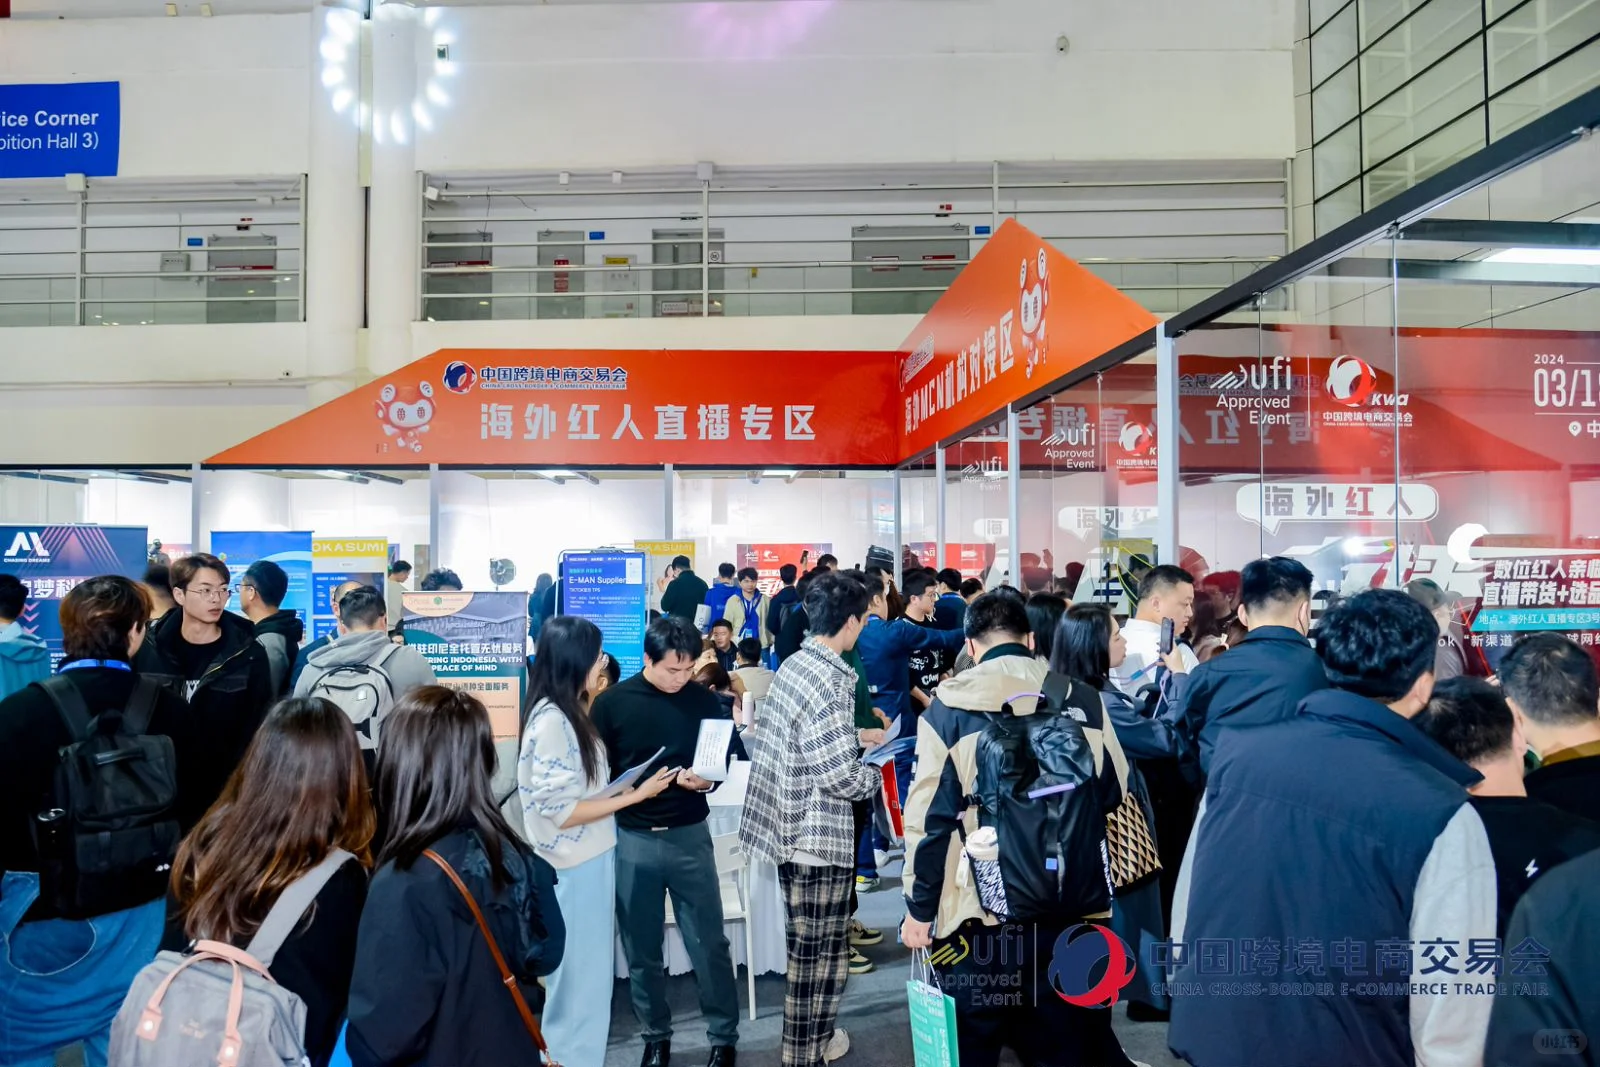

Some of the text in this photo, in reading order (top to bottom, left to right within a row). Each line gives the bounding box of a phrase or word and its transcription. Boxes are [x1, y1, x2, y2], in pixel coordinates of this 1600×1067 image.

[0, 110, 99, 126] ice Corner
[48, 132, 77, 149] Hall
[82, 131, 99, 150] 3)
[1534, 354, 1564, 364] 2024
[480, 367, 627, 382] 中国跨境电商交易会
[1251, 356, 1291, 390] ufi
[1534, 368, 1600, 407] 03/1
[1216, 394, 1290, 411] Approved
[480, 404, 816, 440] 海外红人直播专区
[1249, 410, 1290, 424] Event
[1068, 423, 1095, 446] ufi
[1045, 448, 1095, 459] Approved
[981, 456, 1002, 472] ufi
[1067, 459, 1094, 468] Event
[964, 475, 1000, 483] Approved
[1265, 486, 1413, 516] 海外红人
[597, 577, 630, 585] Supplier
